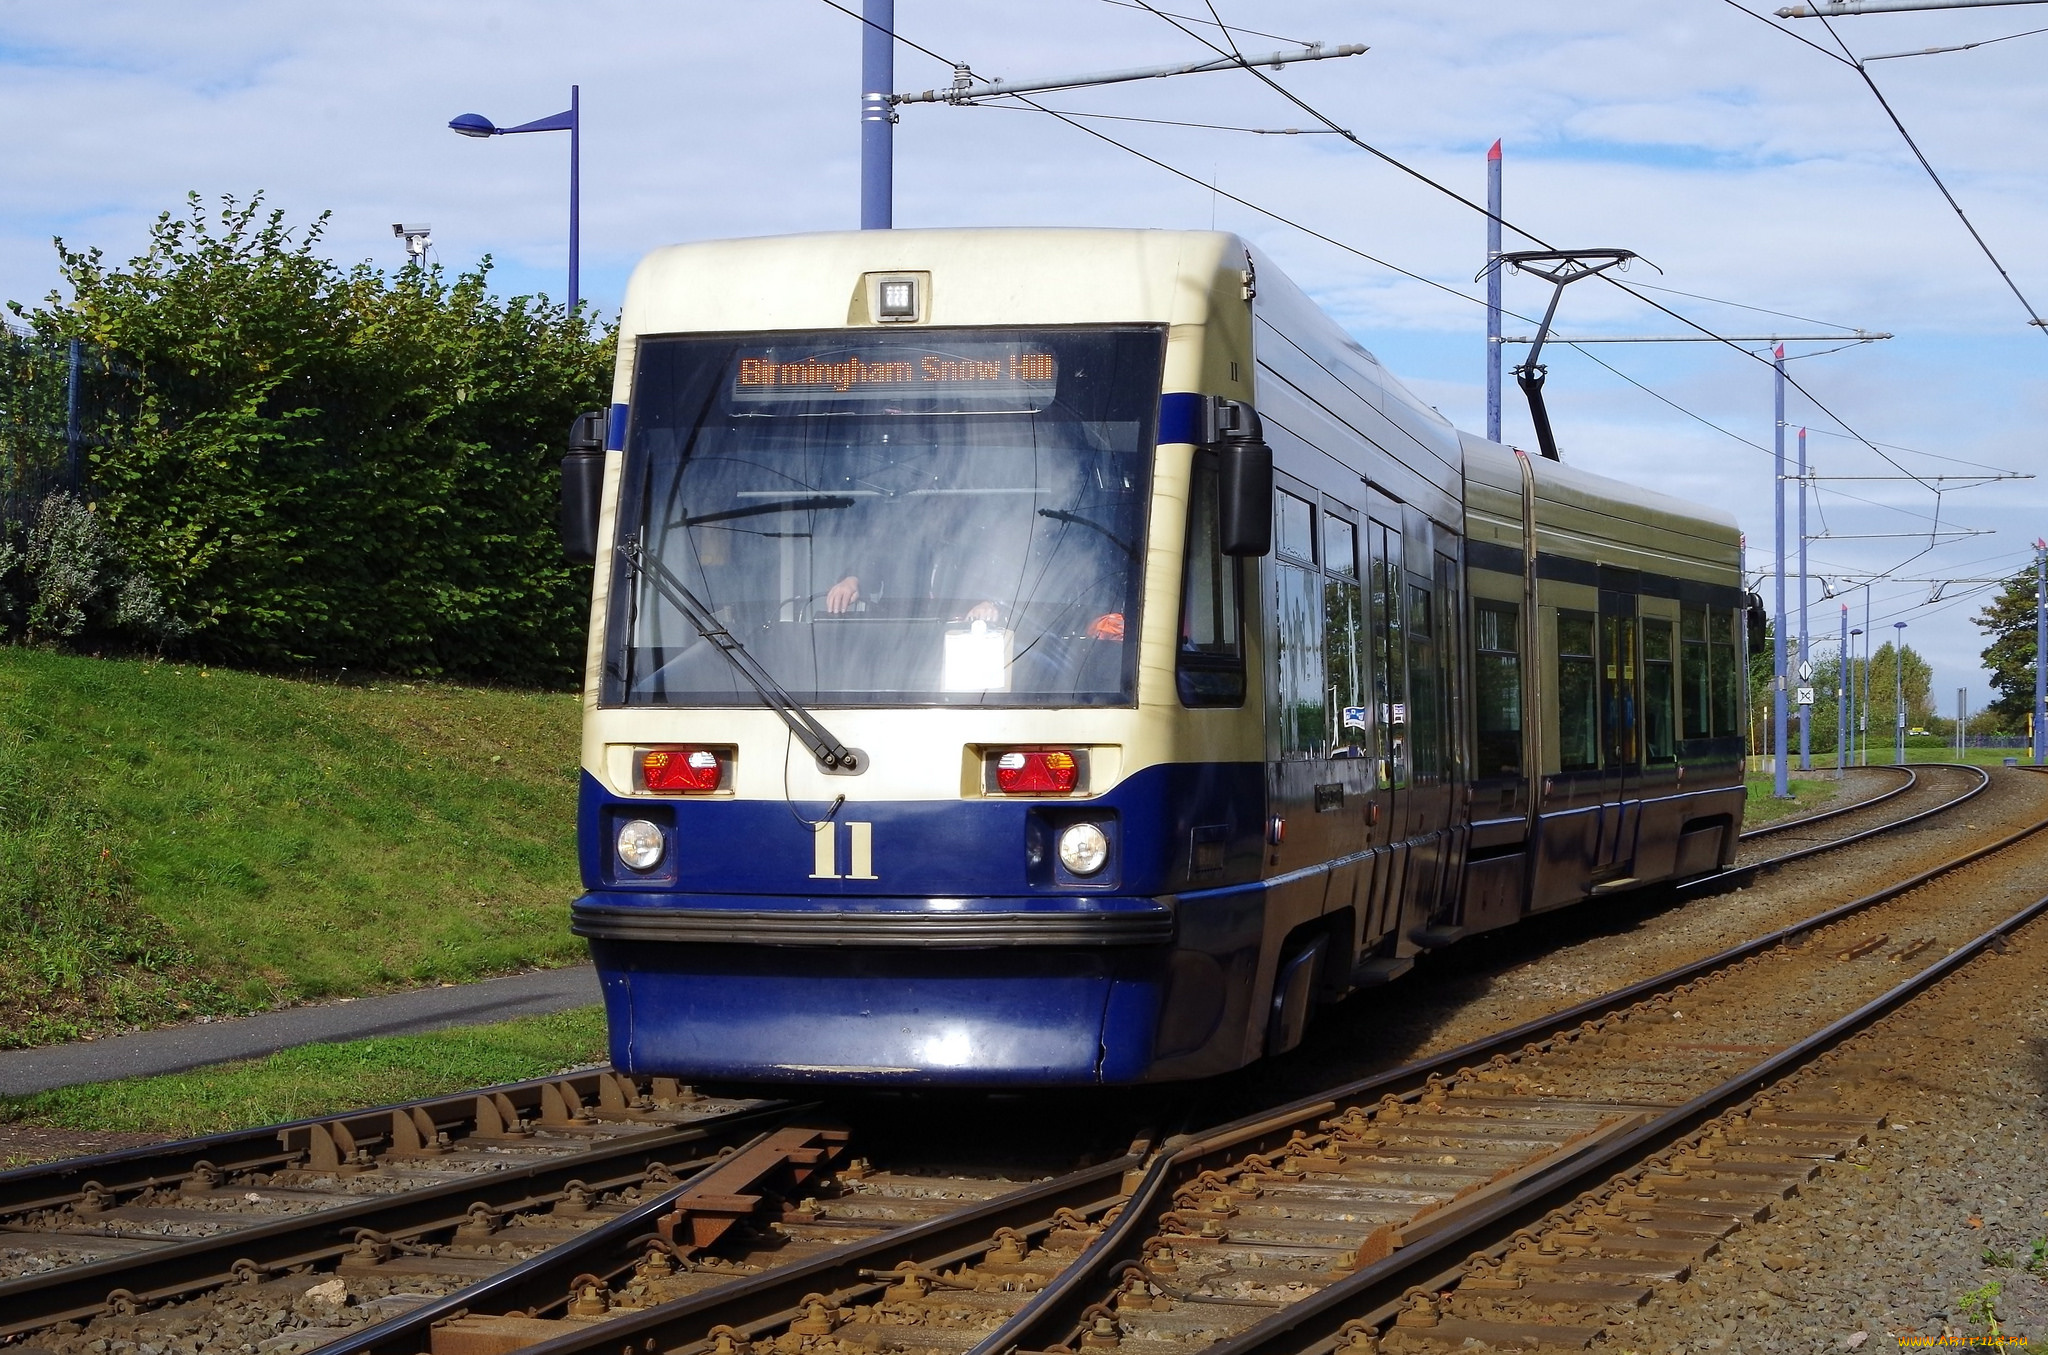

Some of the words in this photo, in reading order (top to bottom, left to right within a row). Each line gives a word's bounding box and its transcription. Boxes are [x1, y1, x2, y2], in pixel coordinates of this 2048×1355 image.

[741, 357, 912, 391] Birmingham
[921, 356, 1001, 381] Snow
[1010, 354, 1052, 380] Hill
[808, 821, 879, 880] 11
